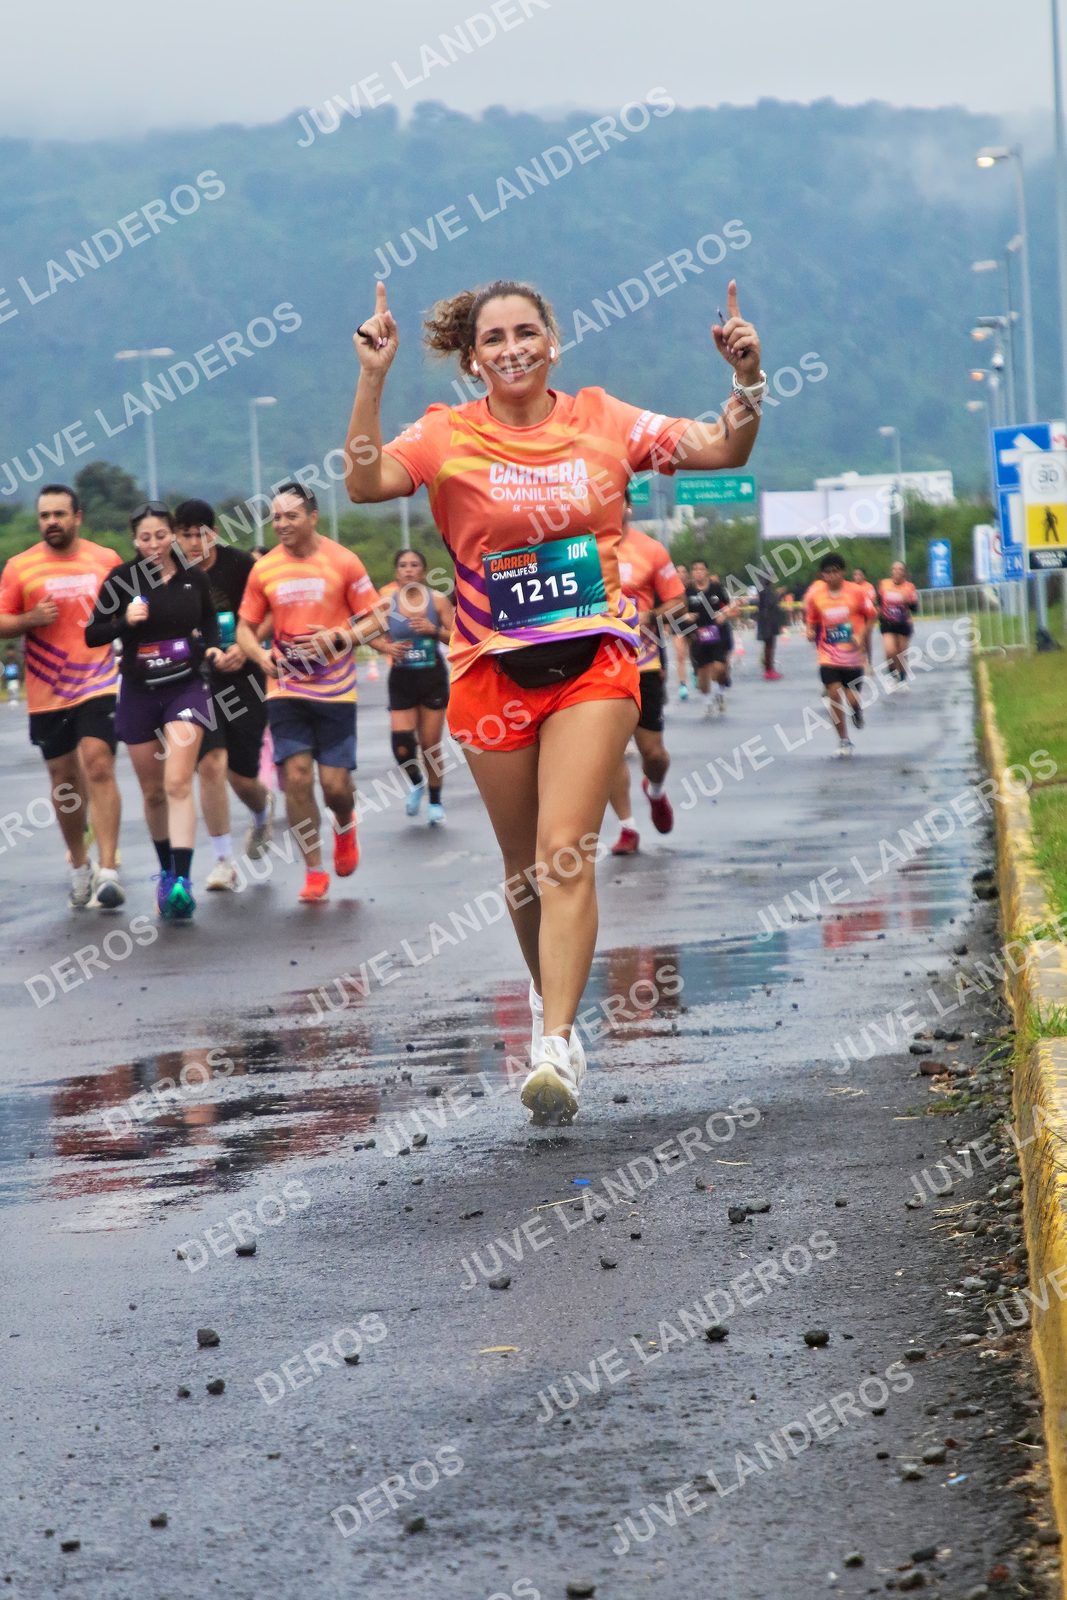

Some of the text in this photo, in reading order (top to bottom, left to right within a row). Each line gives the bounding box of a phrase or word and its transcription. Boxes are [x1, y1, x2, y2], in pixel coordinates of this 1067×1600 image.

[489, 458, 588, 485] CARRERA
[490, 552, 537, 572] CARRERA
[567, 541, 588, 560] 10K
[510, 572, 578, 605] 1215
